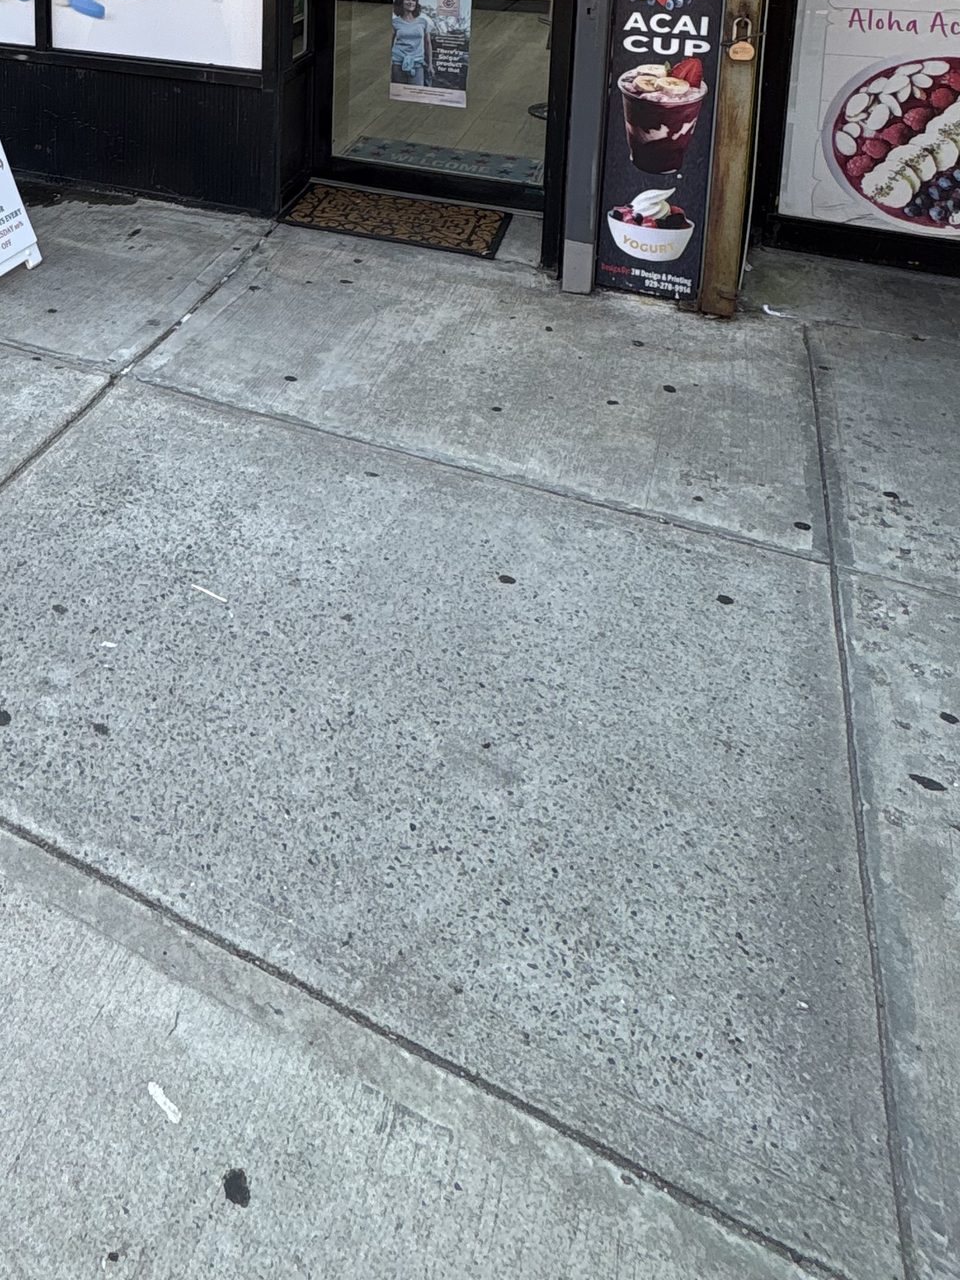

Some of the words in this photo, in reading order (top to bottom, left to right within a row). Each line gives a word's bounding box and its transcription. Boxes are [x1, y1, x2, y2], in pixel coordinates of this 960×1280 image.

[623, 12, 709, 36] ACAI
[848, 8, 919, 35] Aloha
[622, 35, 712, 57] CUP
[5, 208, 23, 224] EVERY
[641, 269, 661, 281] Design
[667, 274, 692, 286] Printing
